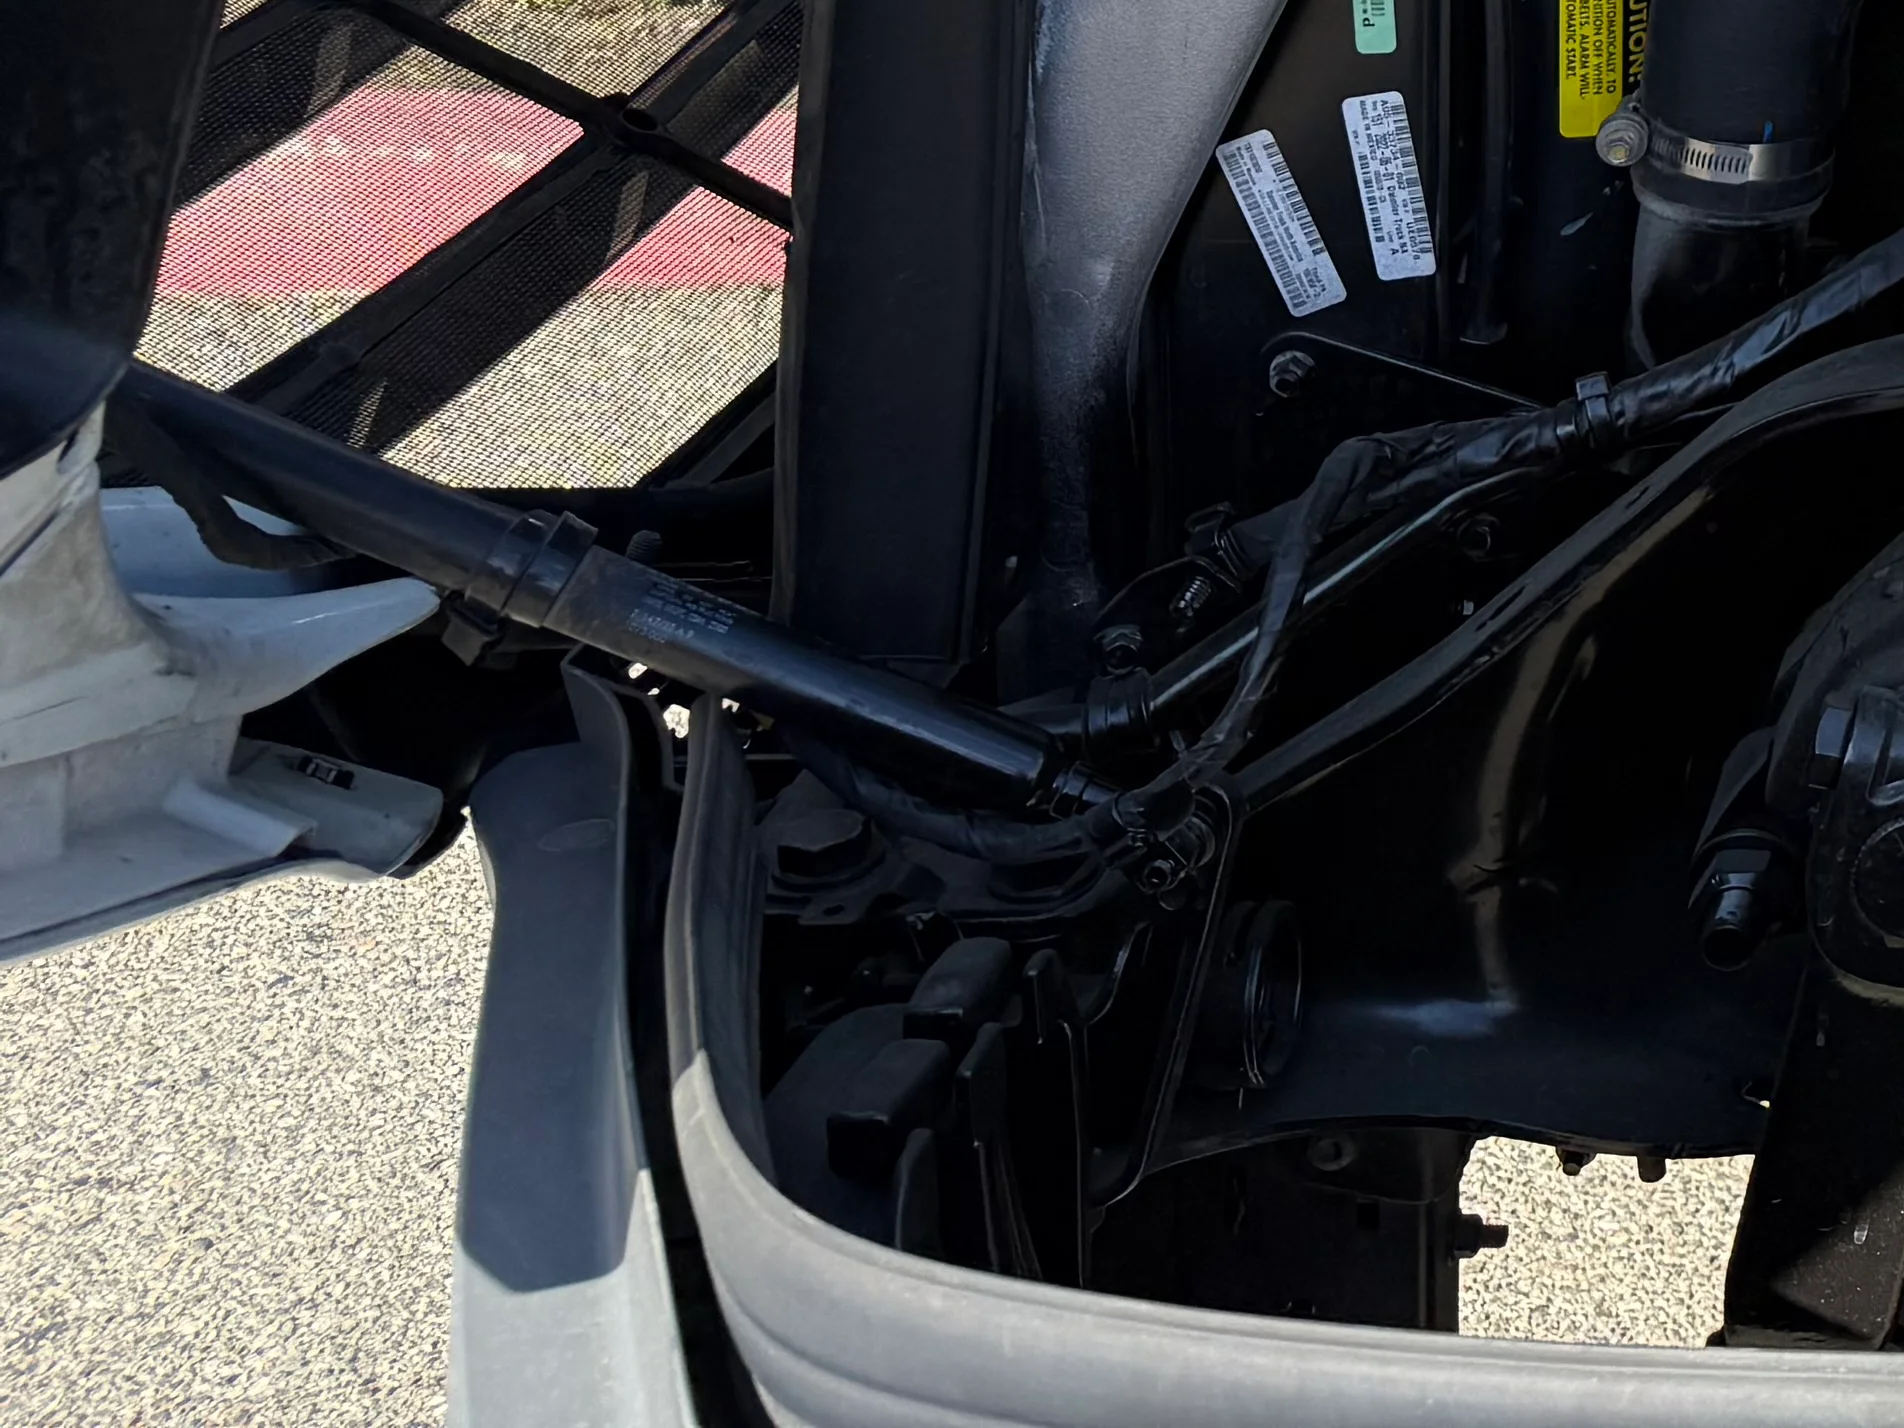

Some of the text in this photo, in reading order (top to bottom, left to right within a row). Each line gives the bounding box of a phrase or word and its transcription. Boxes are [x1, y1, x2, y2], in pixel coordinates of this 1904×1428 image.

[1579, 34, 1589, 69] ALARM
[1593, 39, 1603, 59] OFF
[1593, 63, 1603, 95] WHEN
[1606, 80, 1616, 93] TO
